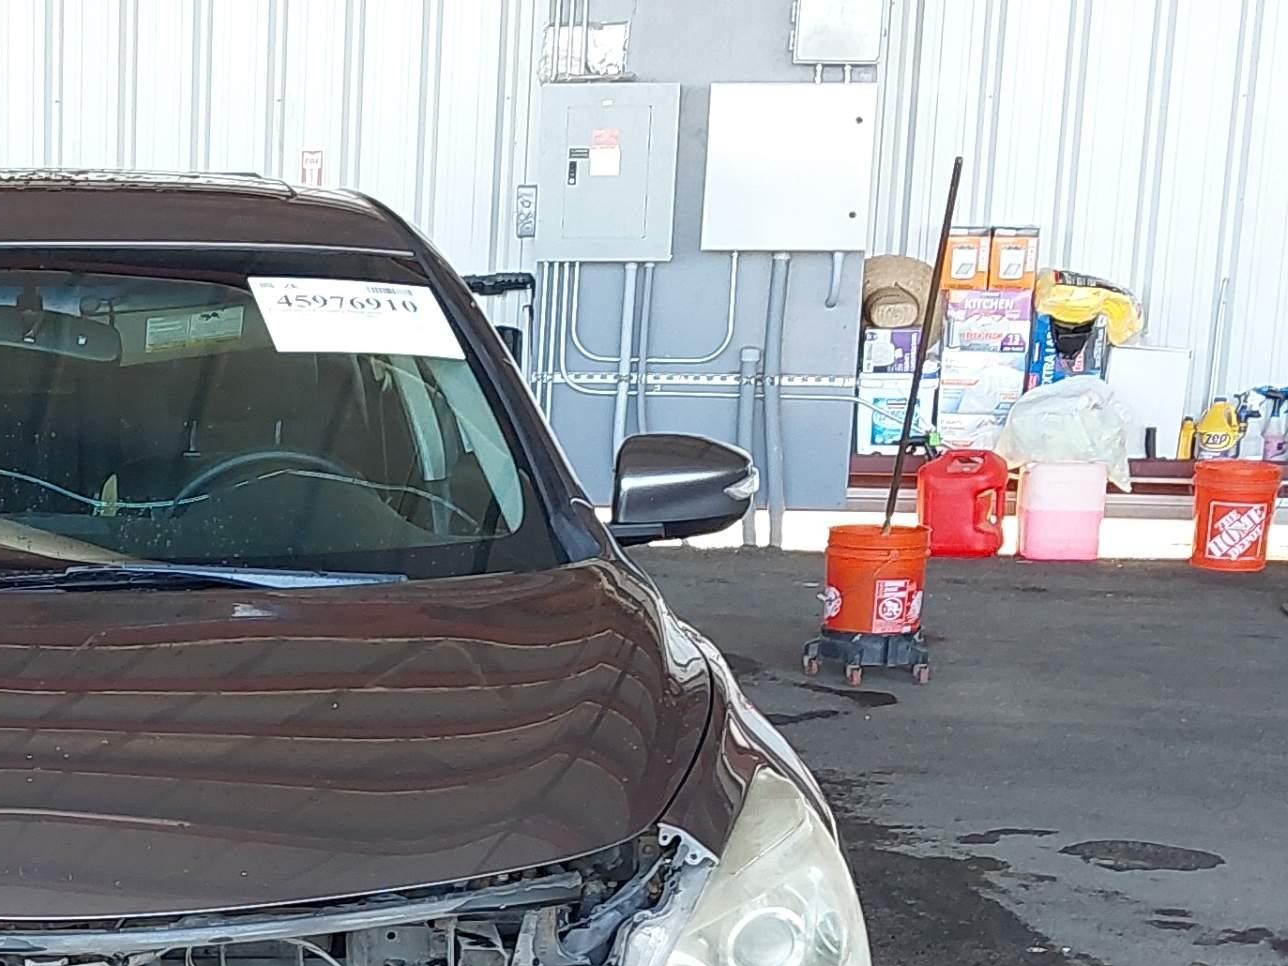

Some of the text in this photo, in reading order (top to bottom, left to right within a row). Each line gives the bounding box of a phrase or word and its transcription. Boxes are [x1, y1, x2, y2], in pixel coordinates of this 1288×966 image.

[276, 293, 419, 313] 45976910
[964, 297, 1014, 311] KITCHEN
[1213, 509, 1241, 531] THE
[1207, 506, 1266, 557] HOME
